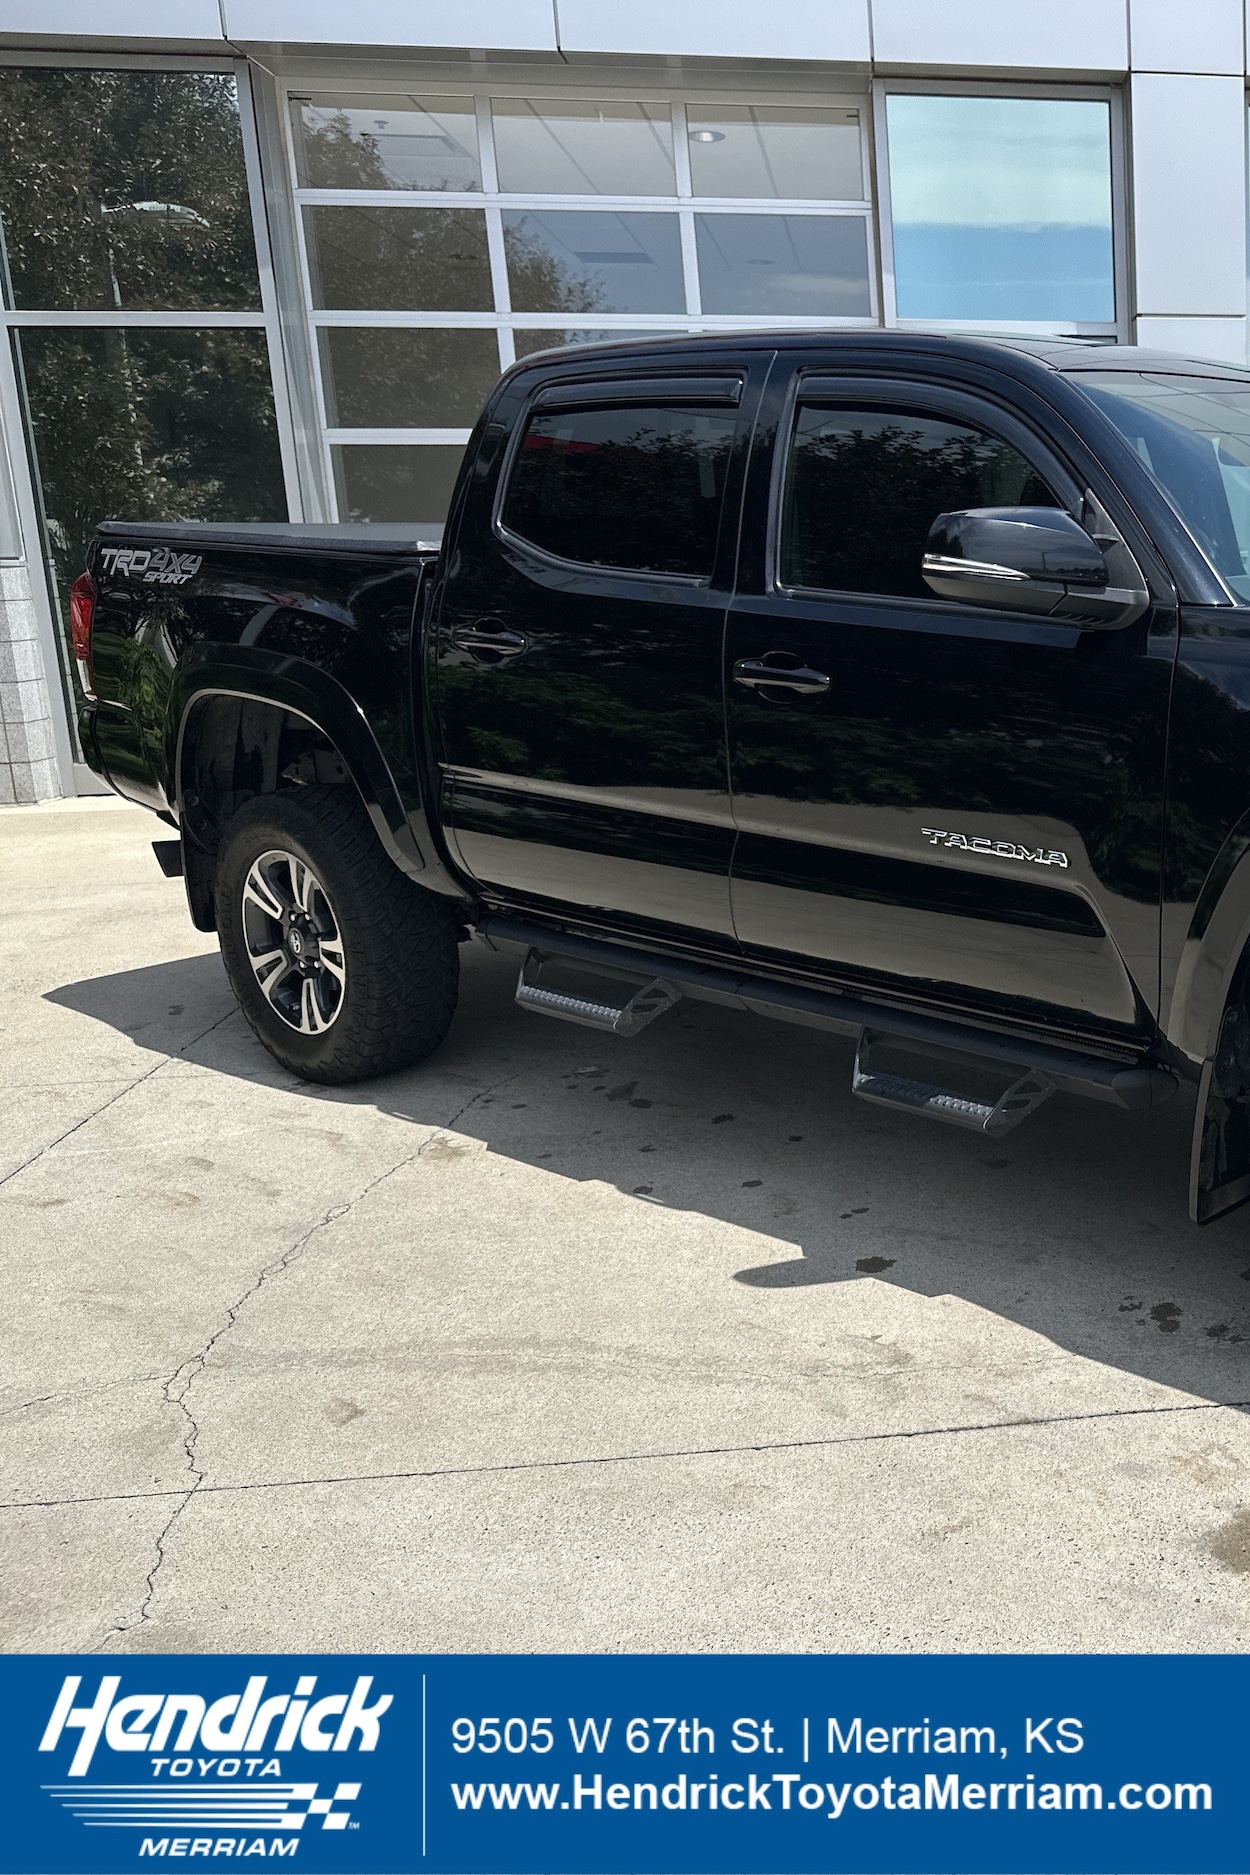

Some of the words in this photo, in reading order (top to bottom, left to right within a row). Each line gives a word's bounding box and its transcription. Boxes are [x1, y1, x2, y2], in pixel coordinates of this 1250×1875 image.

[101, 548, 151, 577] TRD
[150, 551, 203, 575] 4X4
[142, 571, 194, 585] SPORT
[920, 827, 1069, 869] TACOMA
